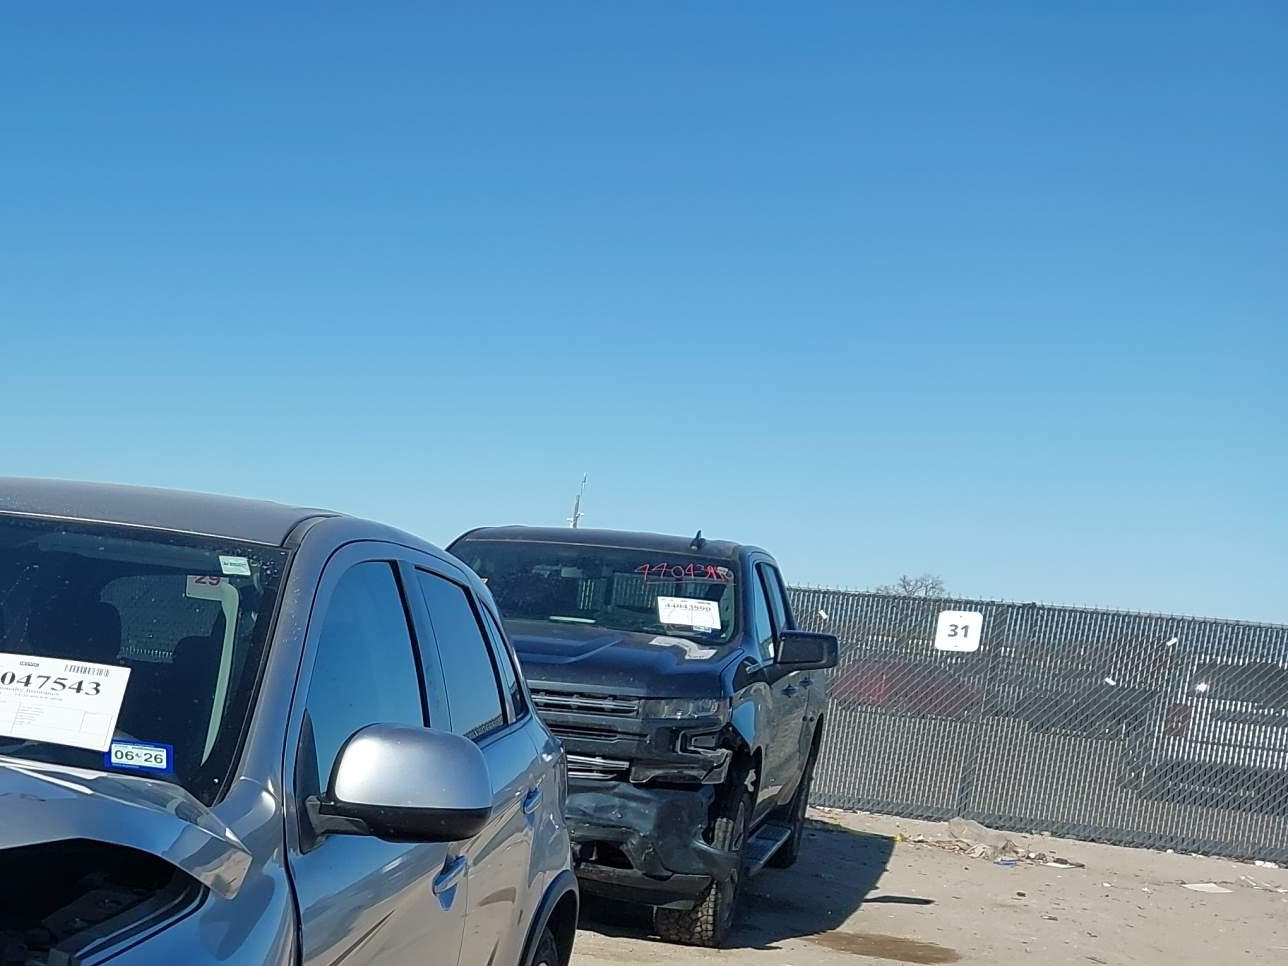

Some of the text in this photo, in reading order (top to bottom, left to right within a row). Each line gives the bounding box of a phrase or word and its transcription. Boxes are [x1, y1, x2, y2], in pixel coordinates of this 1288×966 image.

[947, 623, 970, 638] 31
[114, 749, 164, 764] 06 26
